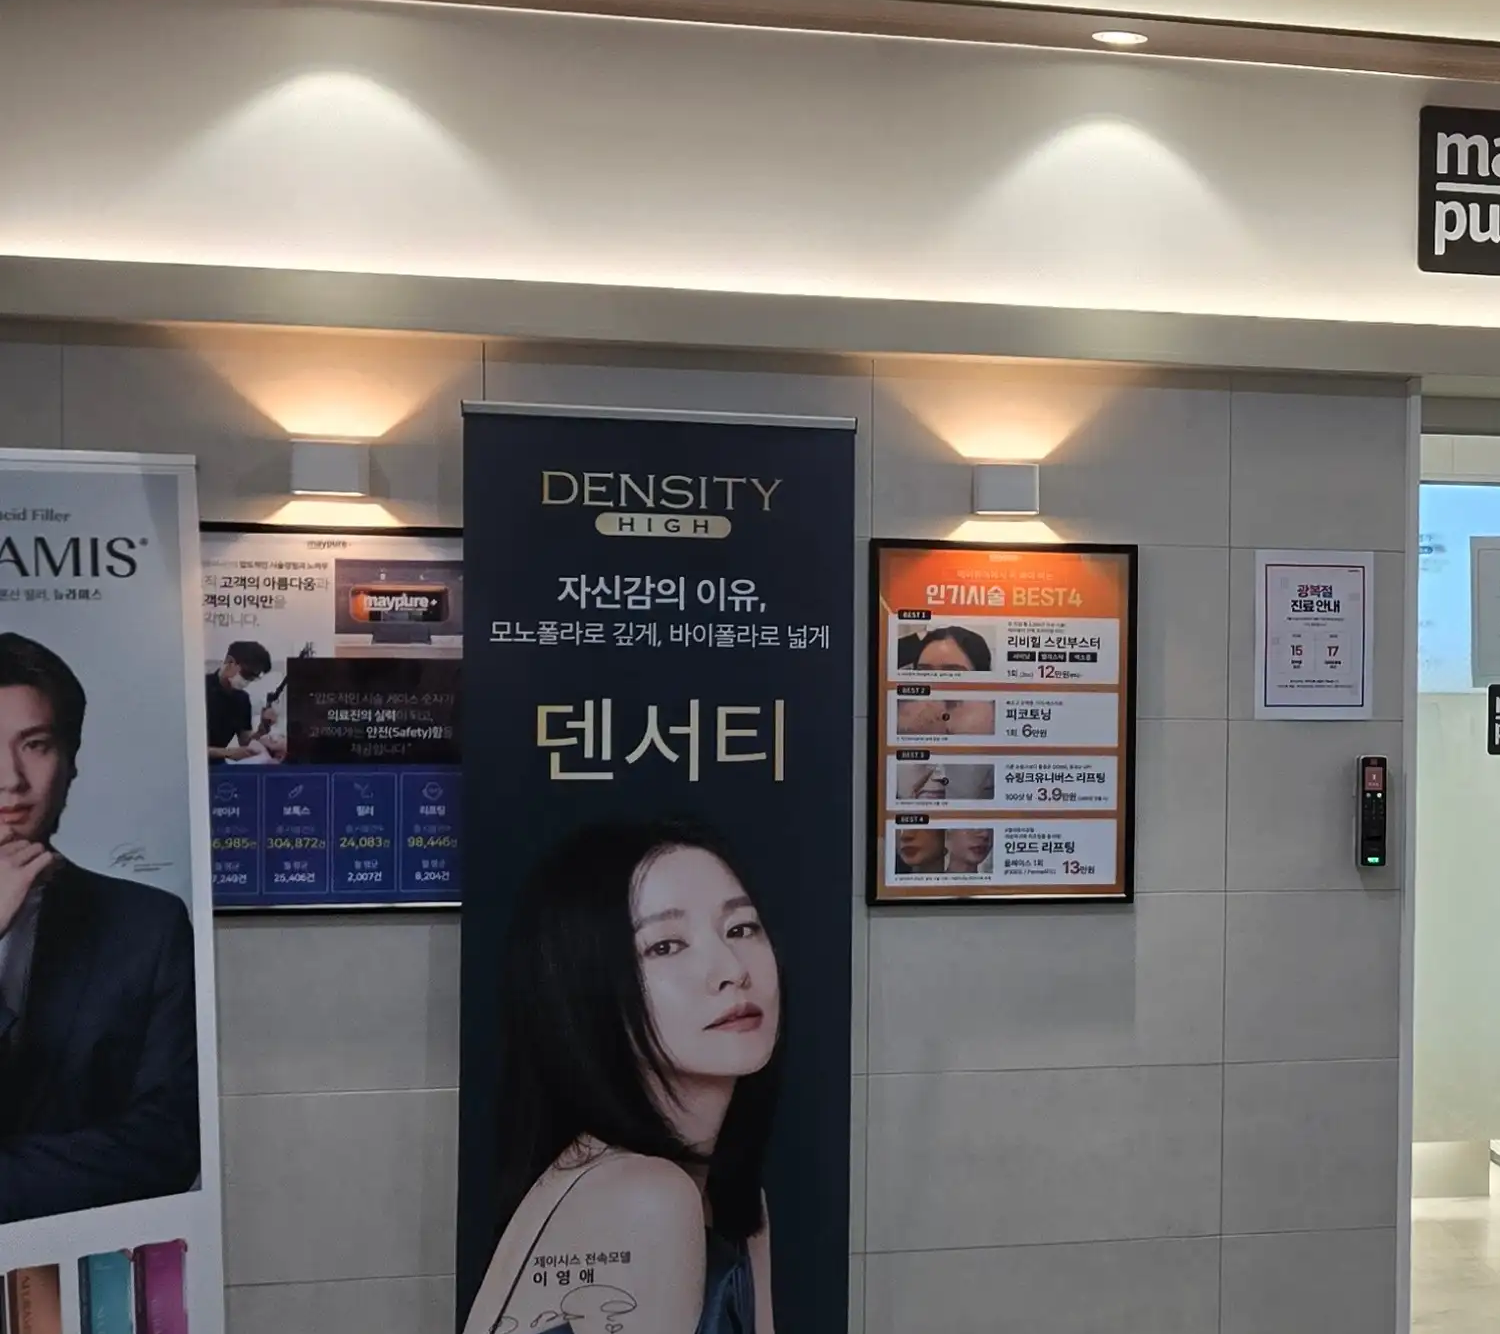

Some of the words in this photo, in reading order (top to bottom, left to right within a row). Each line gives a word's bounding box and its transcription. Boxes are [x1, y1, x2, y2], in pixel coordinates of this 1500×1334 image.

[542, 471, 783, 511] DENSITY
[32, 509, 71, 522] Filler
[618, 517, 709, 535] HIGH
[220, 576, 260, 589] 고객의
[558, 574, 685, 610] 자신감의
[697, 577, 767, 613] 이유,
[926, 584, 1006, 607] 인기시술
[1012, 586, 1083, 608] BEST4
[1297, 584, 1333, 598] 광복절
[1291, 599, 1315, 613] 진료
[1316, 599, 1340, 614] 안내
[489, 621, 606, 646] 모노폴라로
[612, 623, 661, 648] 깊게,
[670, 624, 780, 649] 바이폴라로
[788, 626, 830, 650] 넓게
[1008, 635, 1041, 649] 리비힐
[1044, 636, 1101, 650] 스킨부스터
[1290, 645, 1303, 656] 15
[1327, 646, 1339, 657] 17
[1006, 708, 1052, 721] 피코토닝
[1022, 723, 1048, 738] 6만원
[537, 698, 785, 782] 덴서티
[1005, 772, 1074, 784] 슈링크유니버스
[1076, 772, 1106, 784] 리프팅
[1005, 841, 1039, 854] 인모드
[1042, 841, 1075, 854] 리프팅
[1062, 860, 1095, 875] 13만원
[534, 1253, 581, 1267] 제이시스
[584, 1251, 631, 1266] 전속모델
